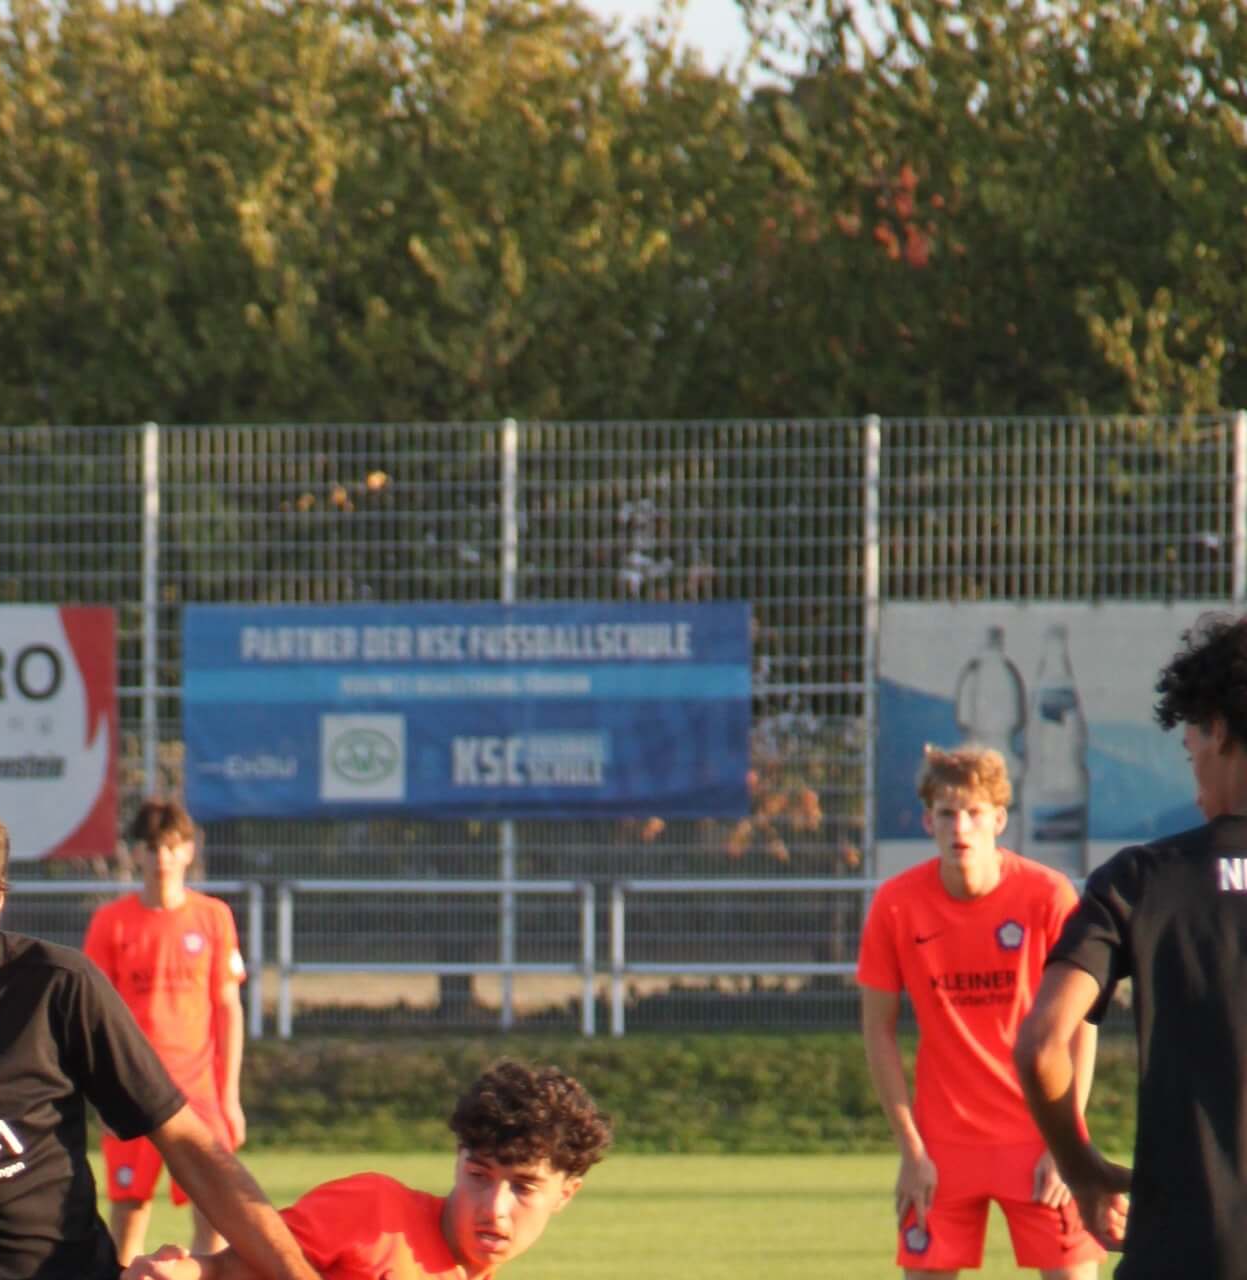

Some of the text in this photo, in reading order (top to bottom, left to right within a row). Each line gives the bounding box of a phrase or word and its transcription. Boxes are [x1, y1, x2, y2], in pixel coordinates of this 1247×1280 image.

[241, 626, 359, 660] PARTNER
[362, 626, 412, 660] DER
[453, 736, 524, 786] KSC
